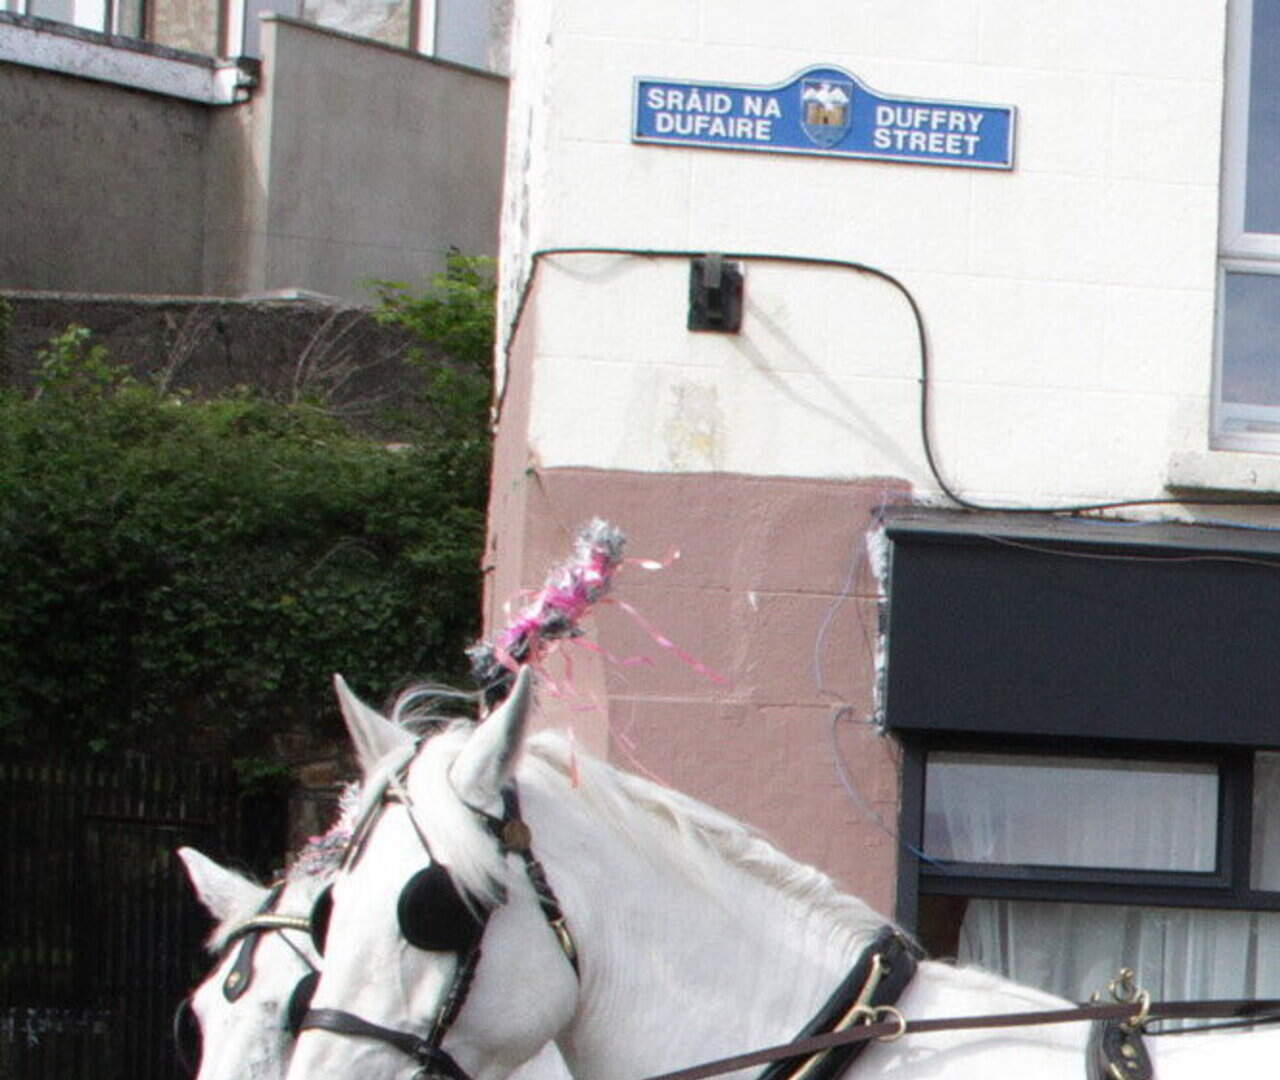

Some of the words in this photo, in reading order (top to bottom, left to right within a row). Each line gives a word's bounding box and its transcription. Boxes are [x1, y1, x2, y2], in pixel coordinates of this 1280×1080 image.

[647, 88, 732, 114] SRÁID
[743, 96, 782, 118] NA
[655, 112, 772, 141] DUFAIRE
[875, 106, 984, 132] DUFFRY
[873, 129, 981, 156] STREET
